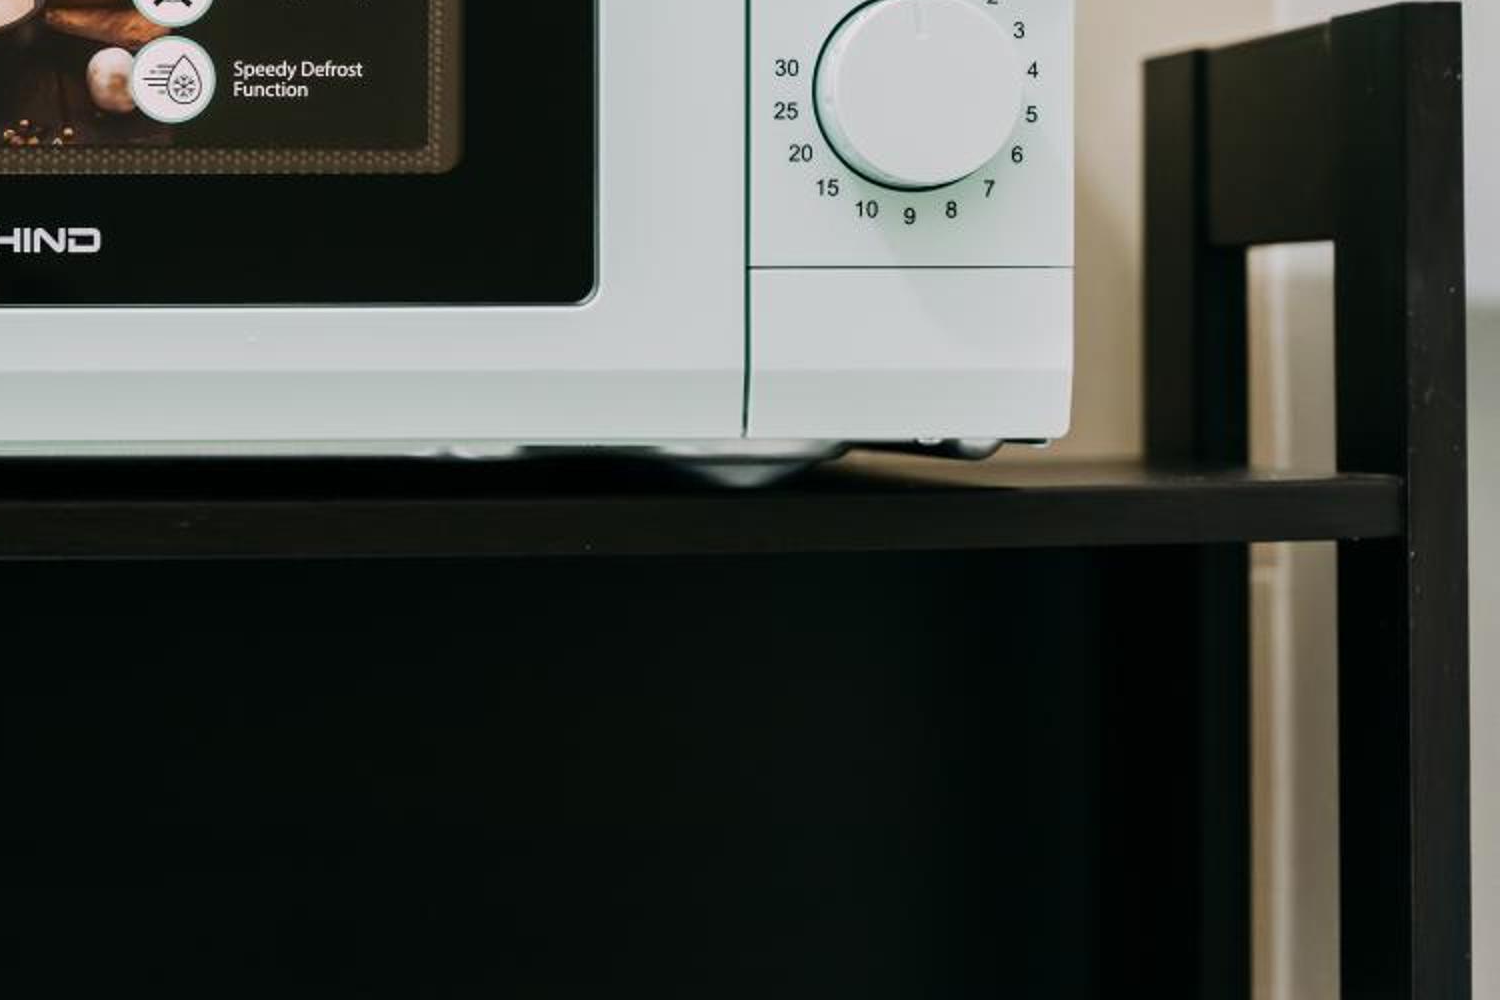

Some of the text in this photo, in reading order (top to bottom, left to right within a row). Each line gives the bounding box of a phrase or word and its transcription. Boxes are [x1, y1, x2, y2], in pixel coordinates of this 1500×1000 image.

[1012, 21, 1026, 39] 3
[233, 60, 364, 82] Speedy Defrost
[774, 59, 800, 77] 30
[1026, 61, 1040, 79] 4
[233, 81, 309, 98] Function
[773, 101, 799, 120] 25
[1024, 105, 1038, 123] 5
[788, 144, 814, 163] 20
[1010, 145, 1024, 163] 6
[816, 179, 840, 198] 15
[983, 180, 996, 198] 7
[855, 200, 879, 219] 10
[903, 206, 917, 225] 9
[945, 201, 958, 219] 8
